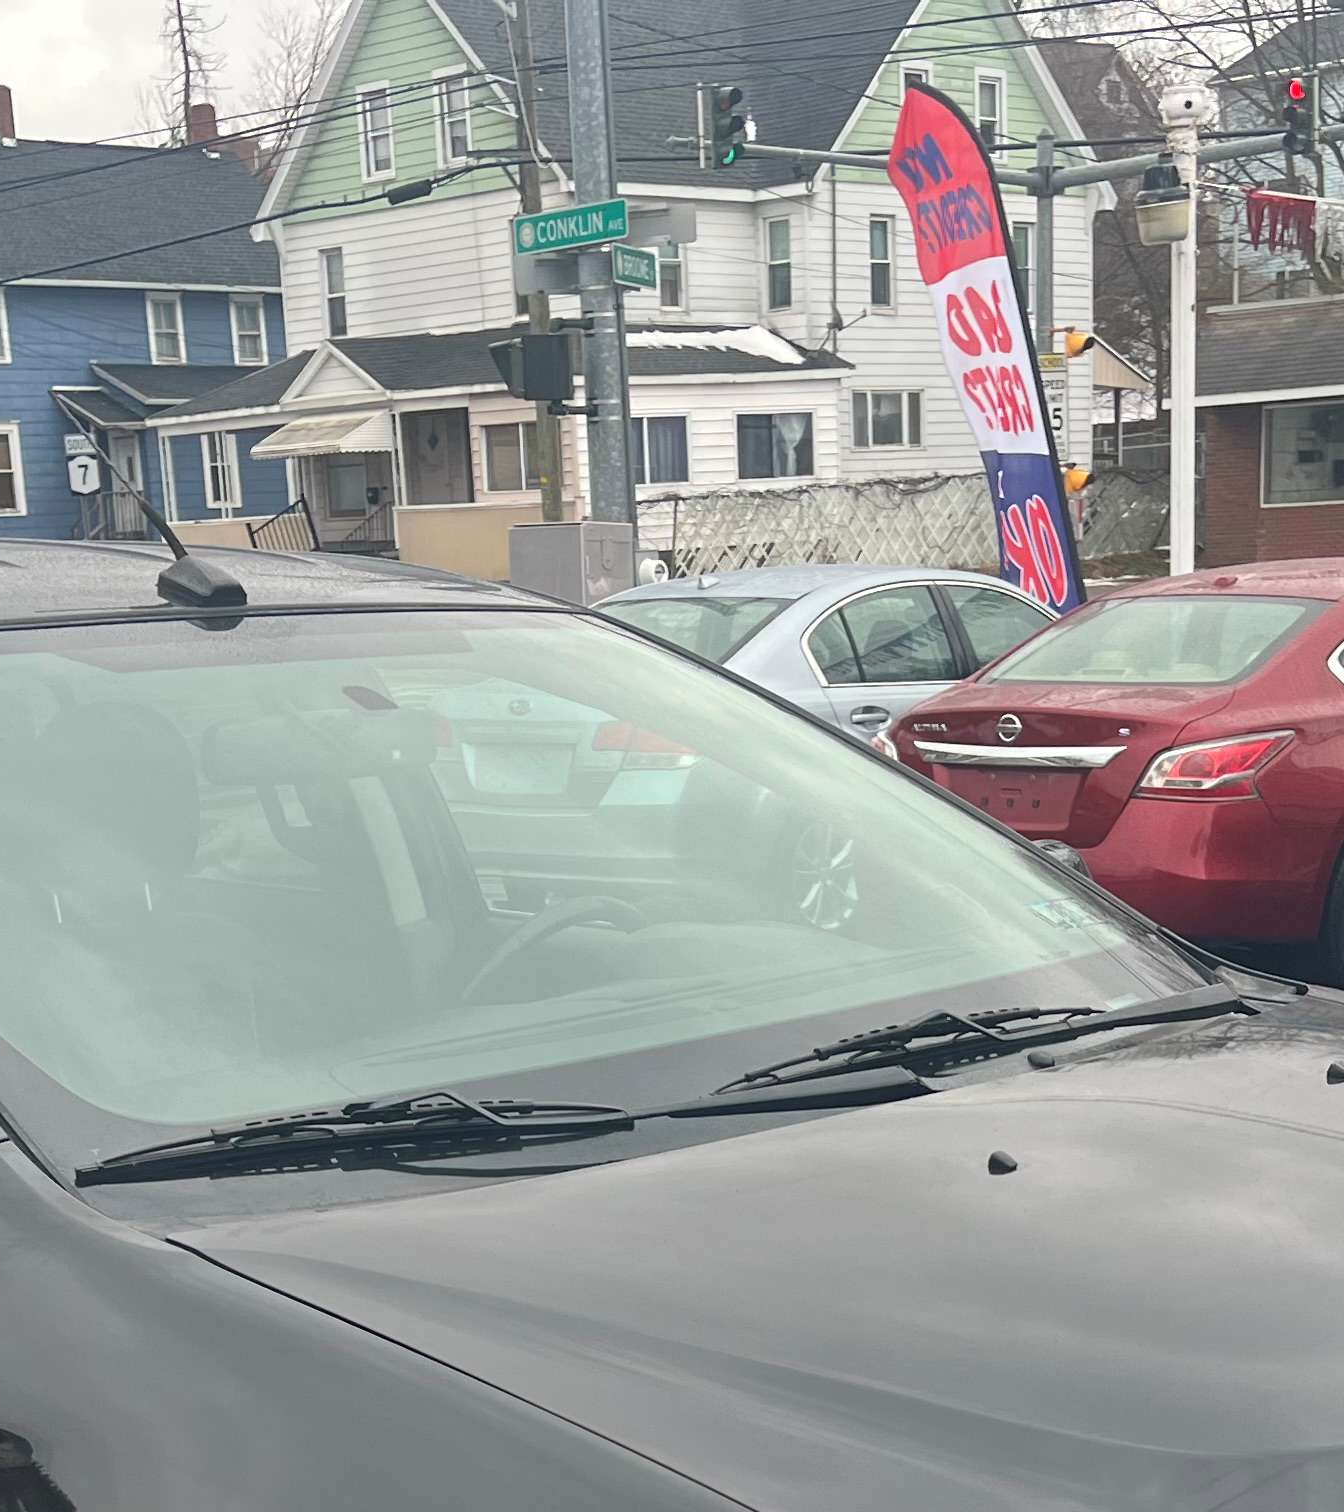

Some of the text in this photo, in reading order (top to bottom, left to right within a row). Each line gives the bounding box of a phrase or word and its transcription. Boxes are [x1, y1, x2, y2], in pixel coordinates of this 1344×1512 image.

[536, 212, 625, 243] CONKLIN AVE
[1051, 407, 1064, 431] 5
[77, 463, 89, 486] 7
